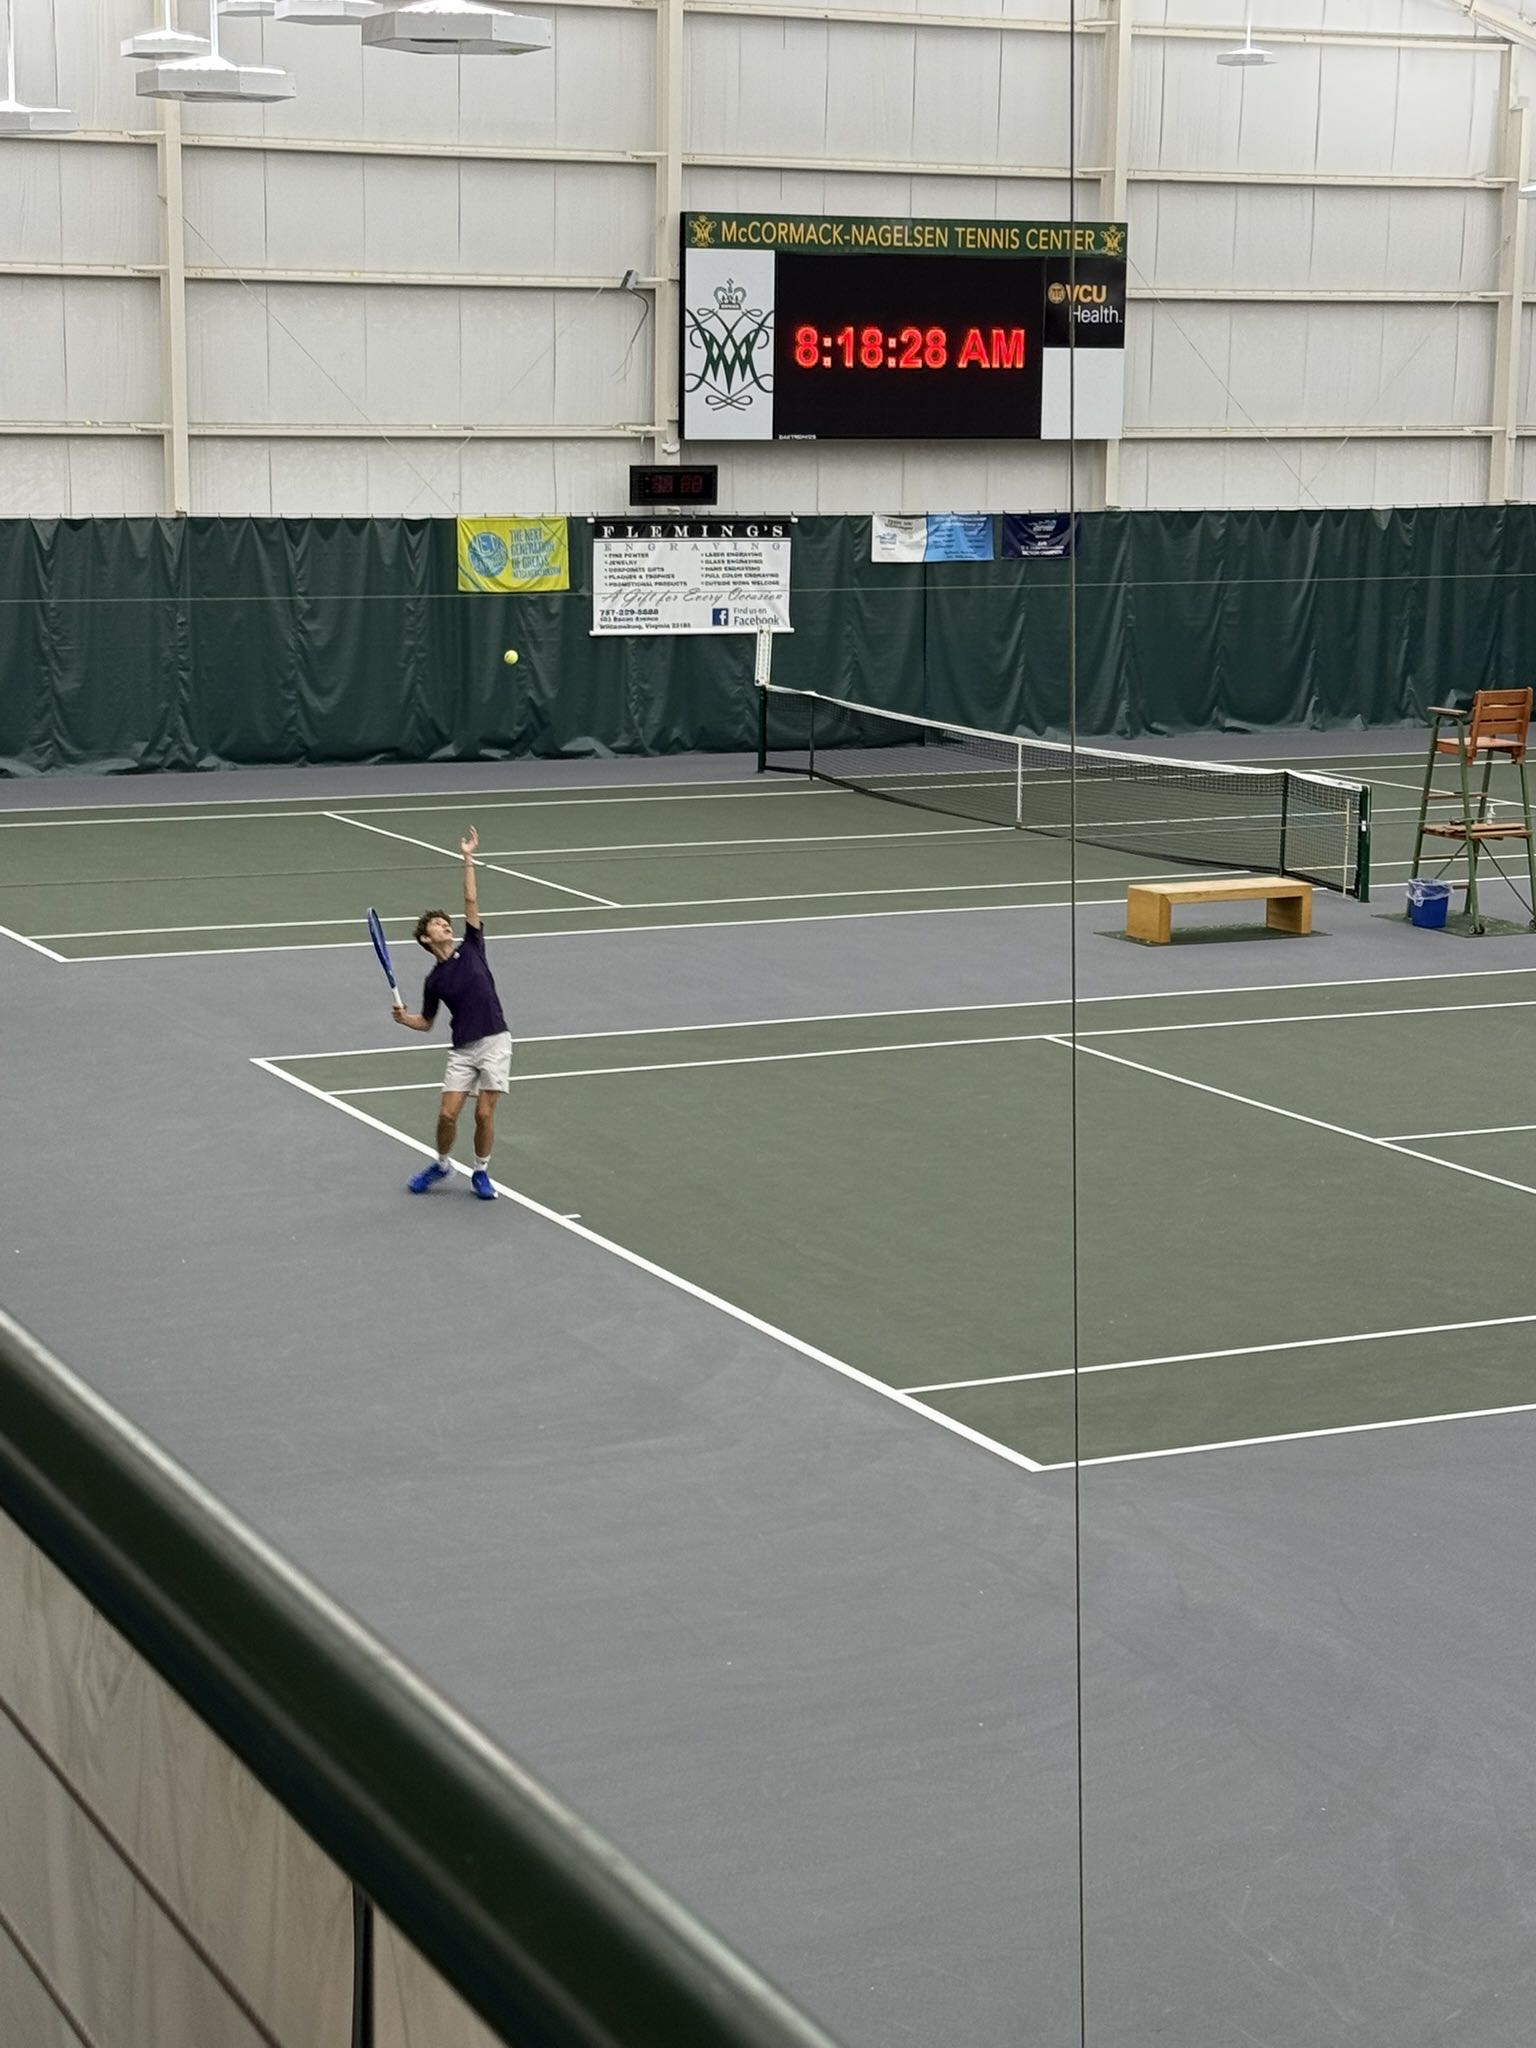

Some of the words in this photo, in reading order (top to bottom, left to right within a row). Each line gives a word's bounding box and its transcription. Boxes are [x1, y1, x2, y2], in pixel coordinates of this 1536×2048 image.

[721, 221, 949, 248] McCORMACK-NAGELSEN
[954, 227, 1020, 249] TENNIS
[1025, 228, 1095, 251] CENTER
[1065, 284, 1107, 303] VCU
[795, 326, 947, 369] 8:18:28
[957, 328, 1026, 369] AM
[509, 528, 525, 543] THE
[524, 527, 543, 542] NEXT
[511, 541, 555, 556] GENERATION
[604, 542, 781, 552] ENGRAVING
[733, 607, 748, 615] Find
[733, 615, 780, 626] Facebook
